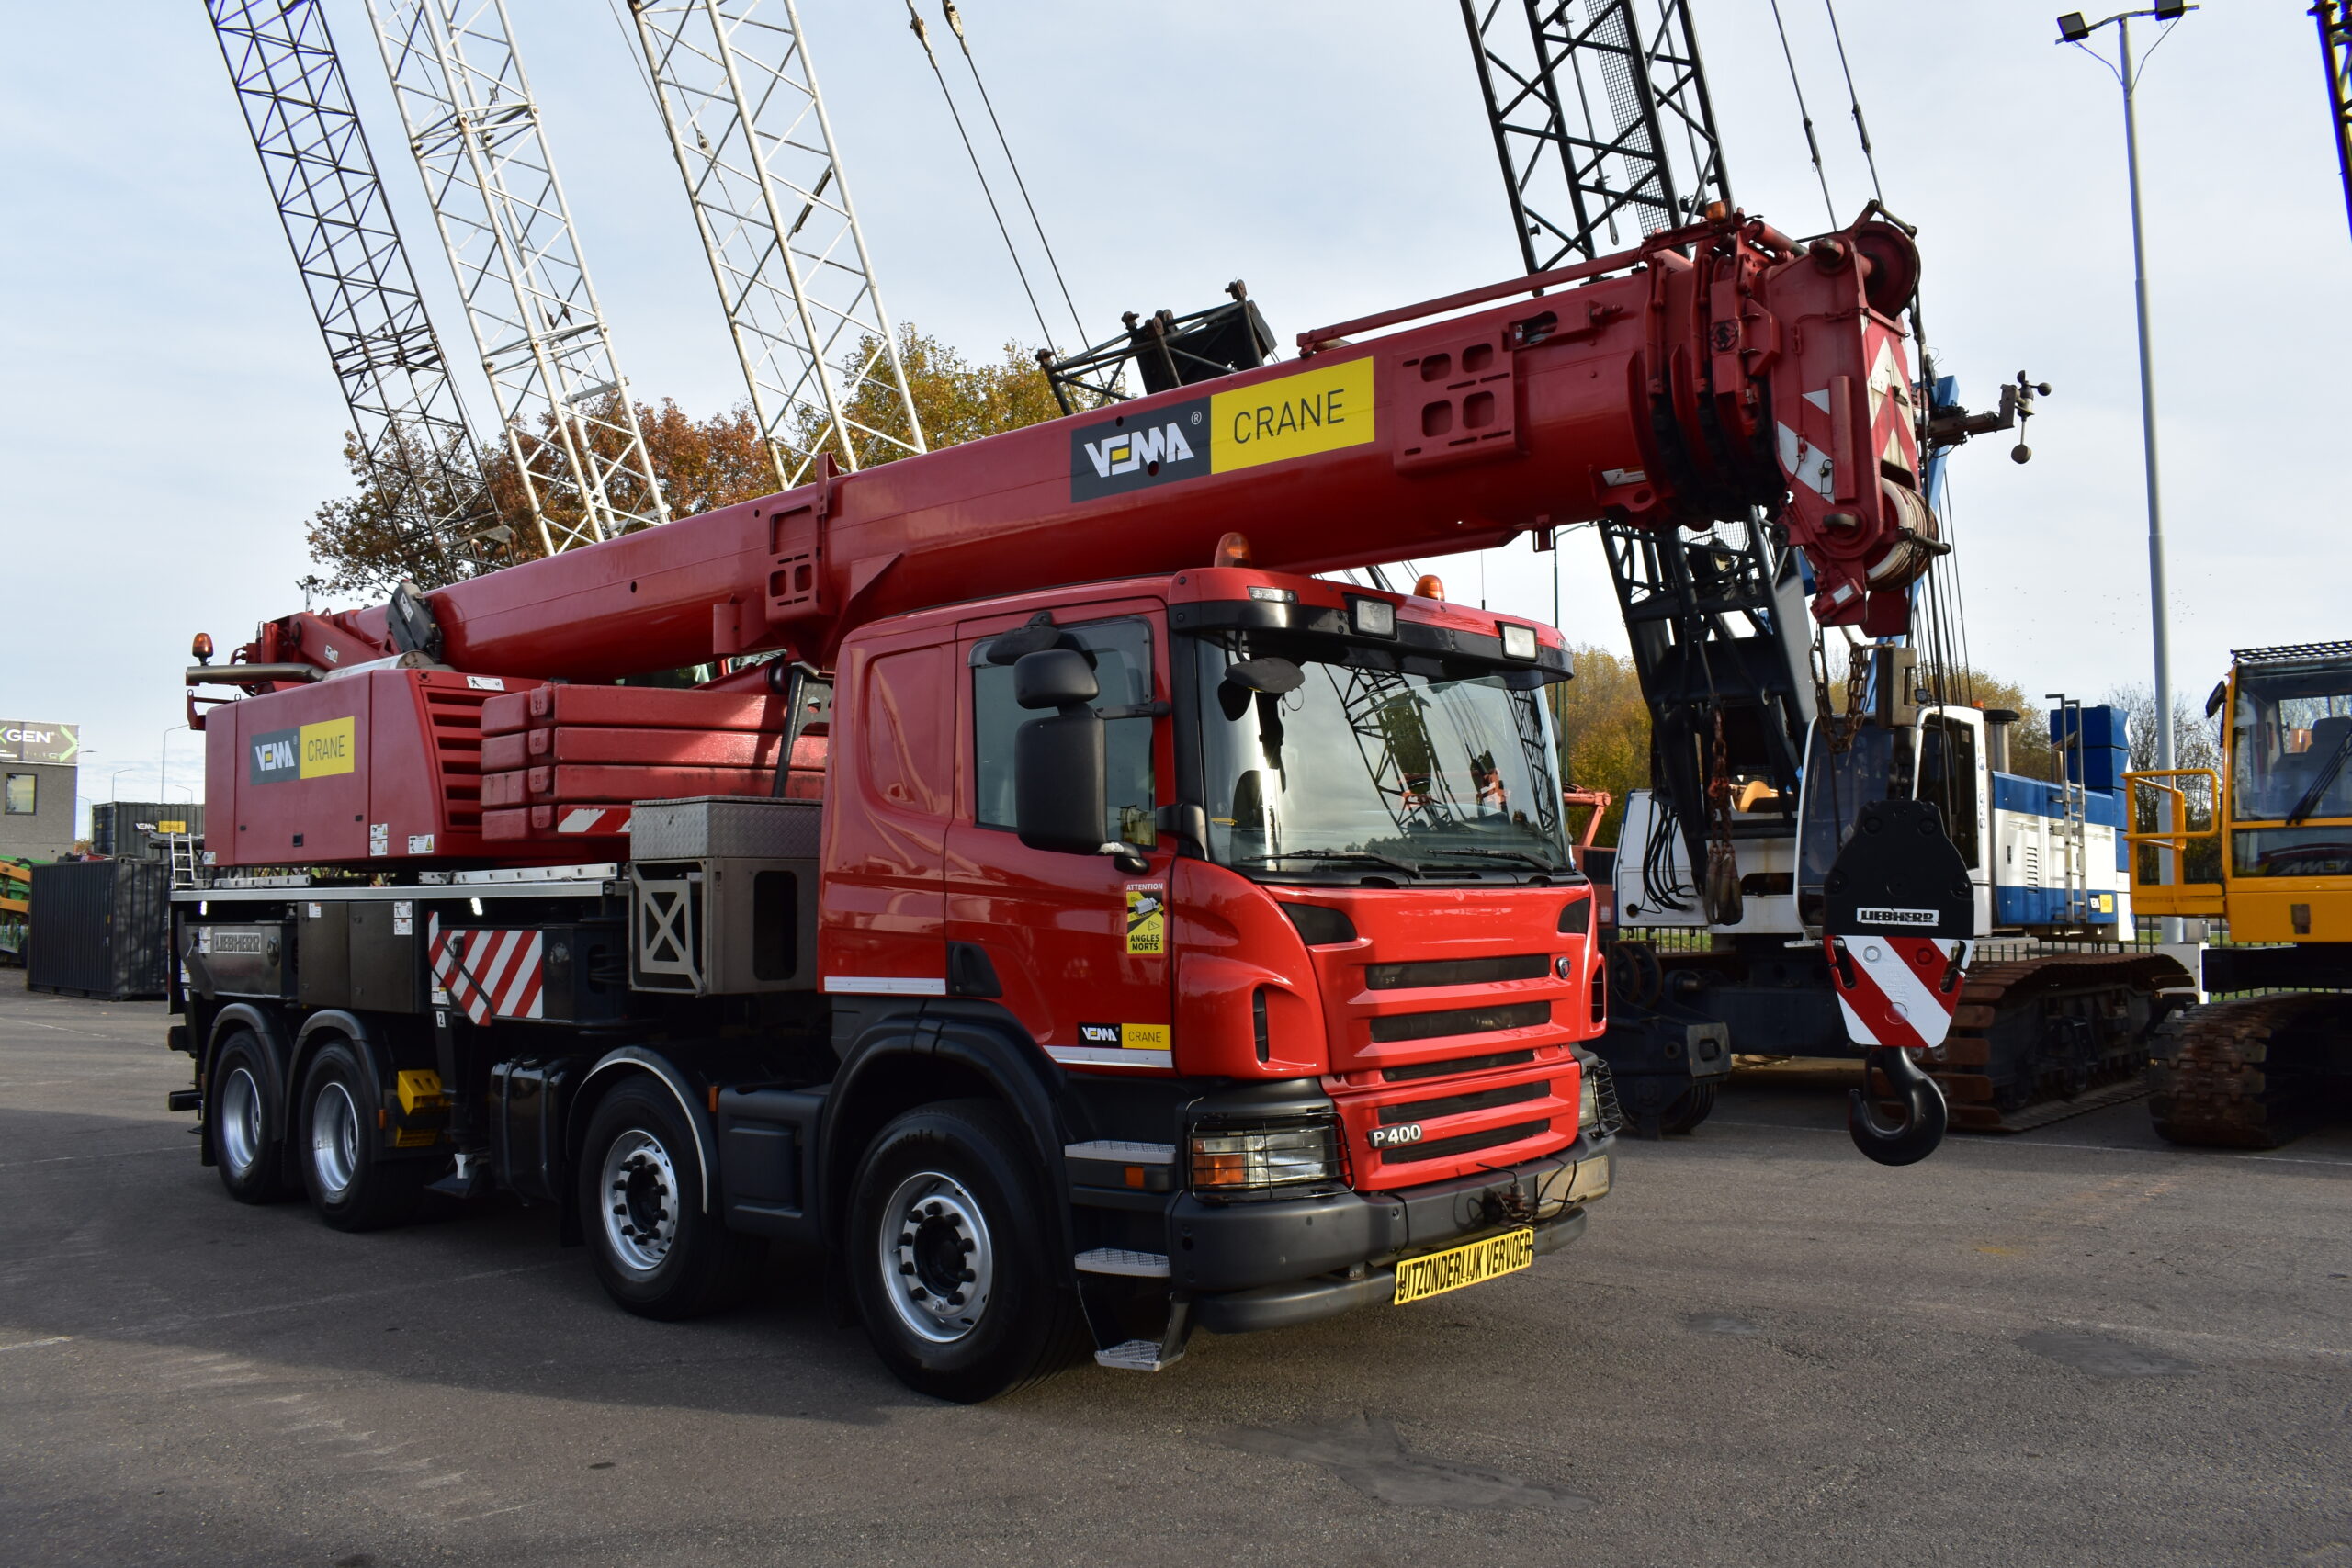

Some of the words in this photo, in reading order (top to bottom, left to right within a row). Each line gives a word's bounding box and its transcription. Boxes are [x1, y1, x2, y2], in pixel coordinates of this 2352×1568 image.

[1084, 423, 1194, 478] VEMA
[1233, 388, 1345, 444] CRANE
[255, 740, 295, 771] VEMA
[308, 735, 345, 761] CRANE
[1126, 883, 1163, 891] ATTENTION
[1860, 910, 1934, 923] LIEBHERR
[1130, 934, 1160, 942] ANGLES
[1132, 942, 1159, 951] MORTS
[438, 1013, 444, 1025] 2
[1081, 1026, 1118, 1042] VEMA
[1128, 1031, 1162, 1043] CRANE
[1374, 1131, 1385, 1147] P
[1388, 1124, 1421, 1144] 400
[1397, 1245, 1484, 1301] UITZONDERLIJK
[1487, 1231, 1531, 1276] VERVOER
